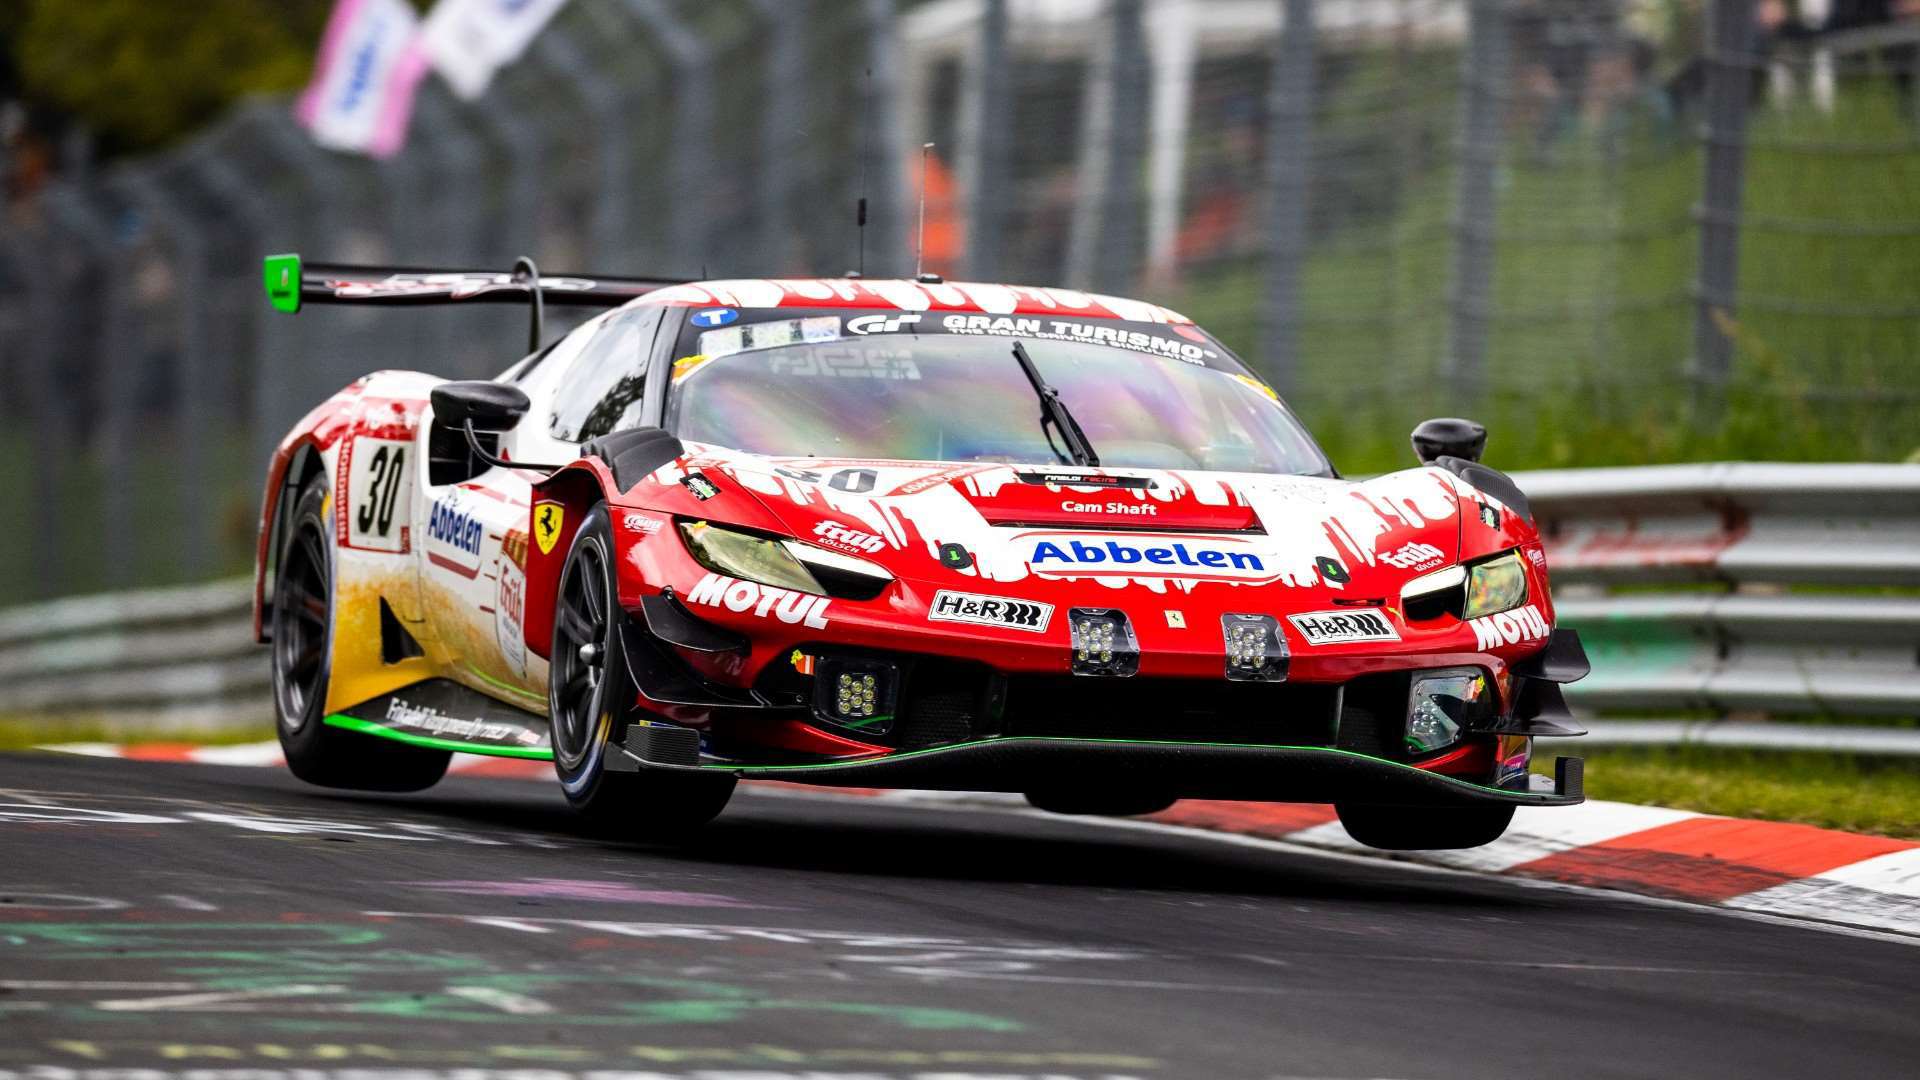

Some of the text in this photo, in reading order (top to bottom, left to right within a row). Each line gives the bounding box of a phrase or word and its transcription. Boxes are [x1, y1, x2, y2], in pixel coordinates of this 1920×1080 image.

[942, 314, 1206, 359] GRAN TURISMO
[949, 328, 1206, 366] THE REAL DRIVING SIMULATOR
[358, 445, 404, 537] 30
[1061, 500, 1157, 516] Cam Shaft
[428, 500, 483, 556] Abbelen
[818, 538, 860, 553] KÖLSCH
[1031, 540, 1265, 571] Abbelen
[687, 572, 832, 630] MOTUL
[938, 595, 1001, 618] H&R
[1300, 615, 1357, 638] H&R
[1471, 604, 1550, 652] MOTUL
